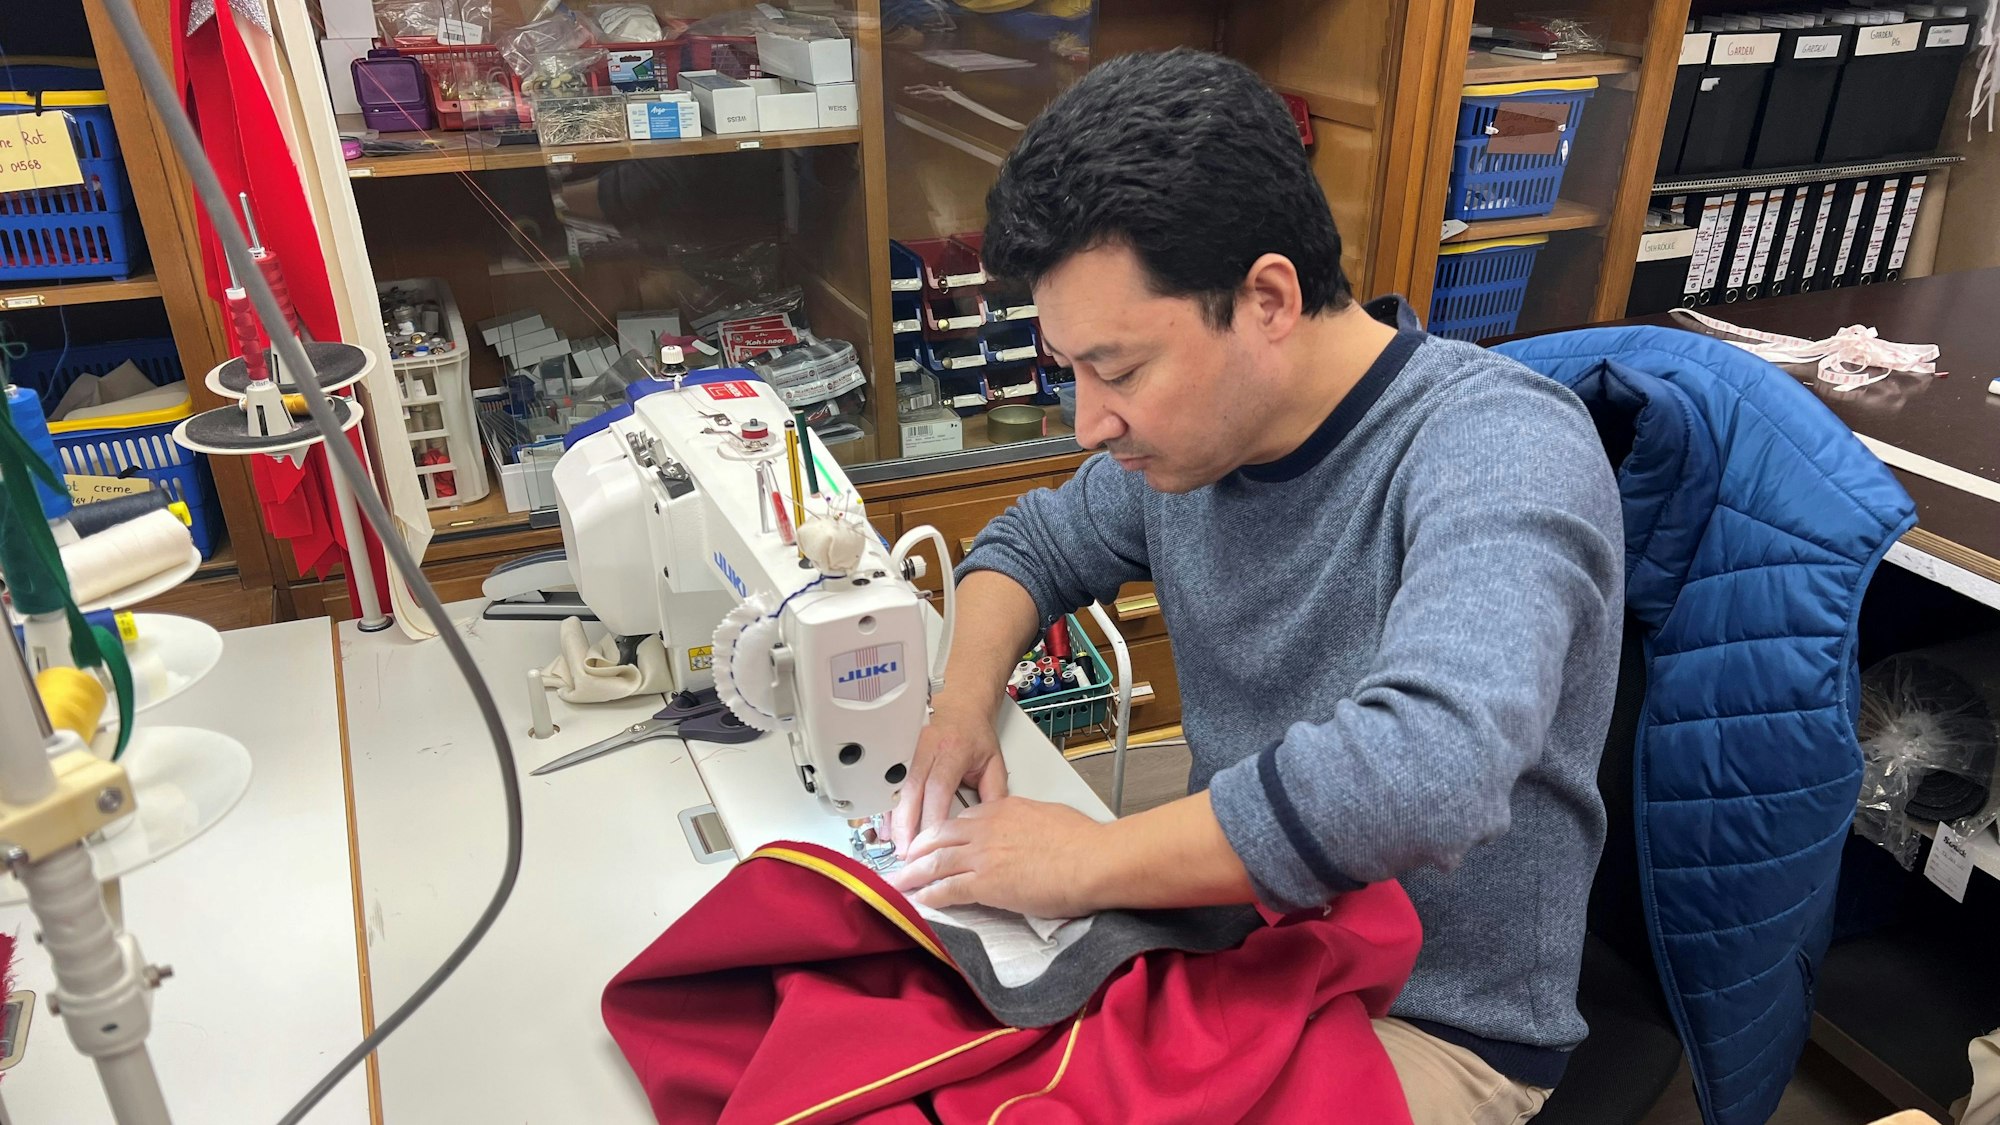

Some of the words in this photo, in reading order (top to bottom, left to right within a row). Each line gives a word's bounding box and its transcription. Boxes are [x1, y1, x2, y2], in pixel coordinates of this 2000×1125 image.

[1727, 42, 1756, 56] GARDEN
[21, 128, 46, 145] Rot
[93, 485, 133, 494] creme
[714, 552, 747, 598] JUKI
[838, 661, 897, 684] JUKI
